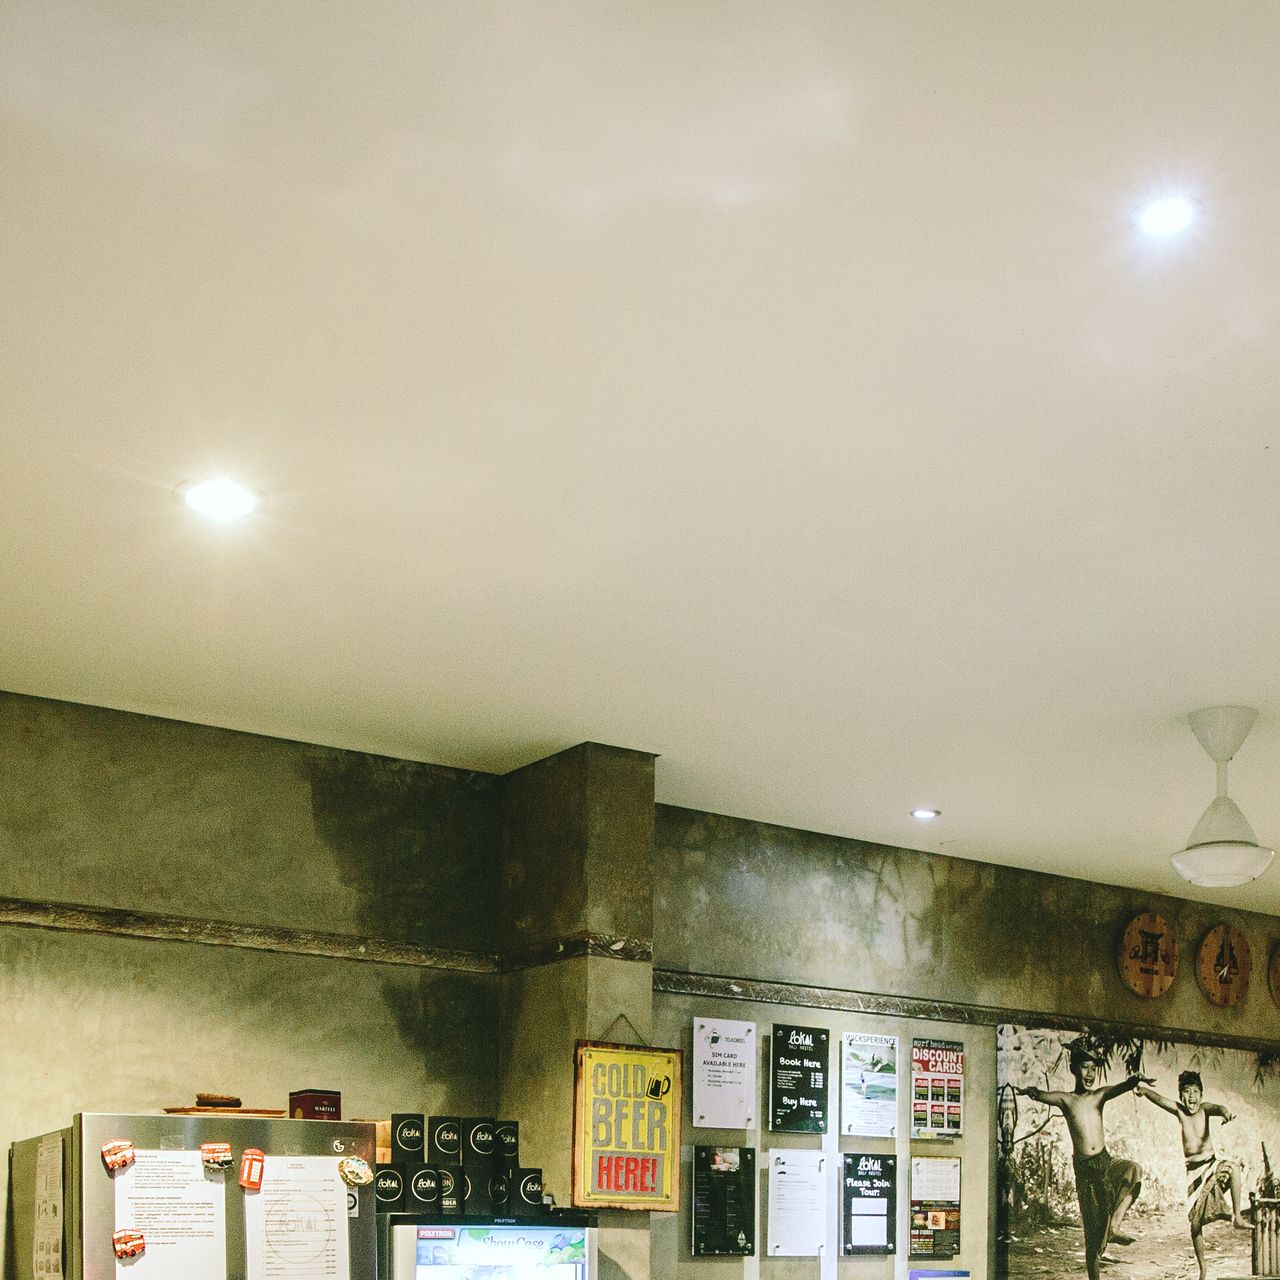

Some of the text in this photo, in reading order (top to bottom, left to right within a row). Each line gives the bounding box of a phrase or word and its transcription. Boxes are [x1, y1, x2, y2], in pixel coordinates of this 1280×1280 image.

[779, 1056, 821, 1068] Book Here
[913, 1047, 964, 1064] DISCOUNT
[928, 1060, 963, 1074] CARDS
[592, 1062, 646, 1099] COLD
[782, 1096, 818, 1109] Buy Here
[592, 1097, 667, 1151] BEER
[597, 1155, 657, 1193] HERE!
[846, 1178, 891, 1188] Please Join
[420, 1230, 453, 1238] POLYTRON
